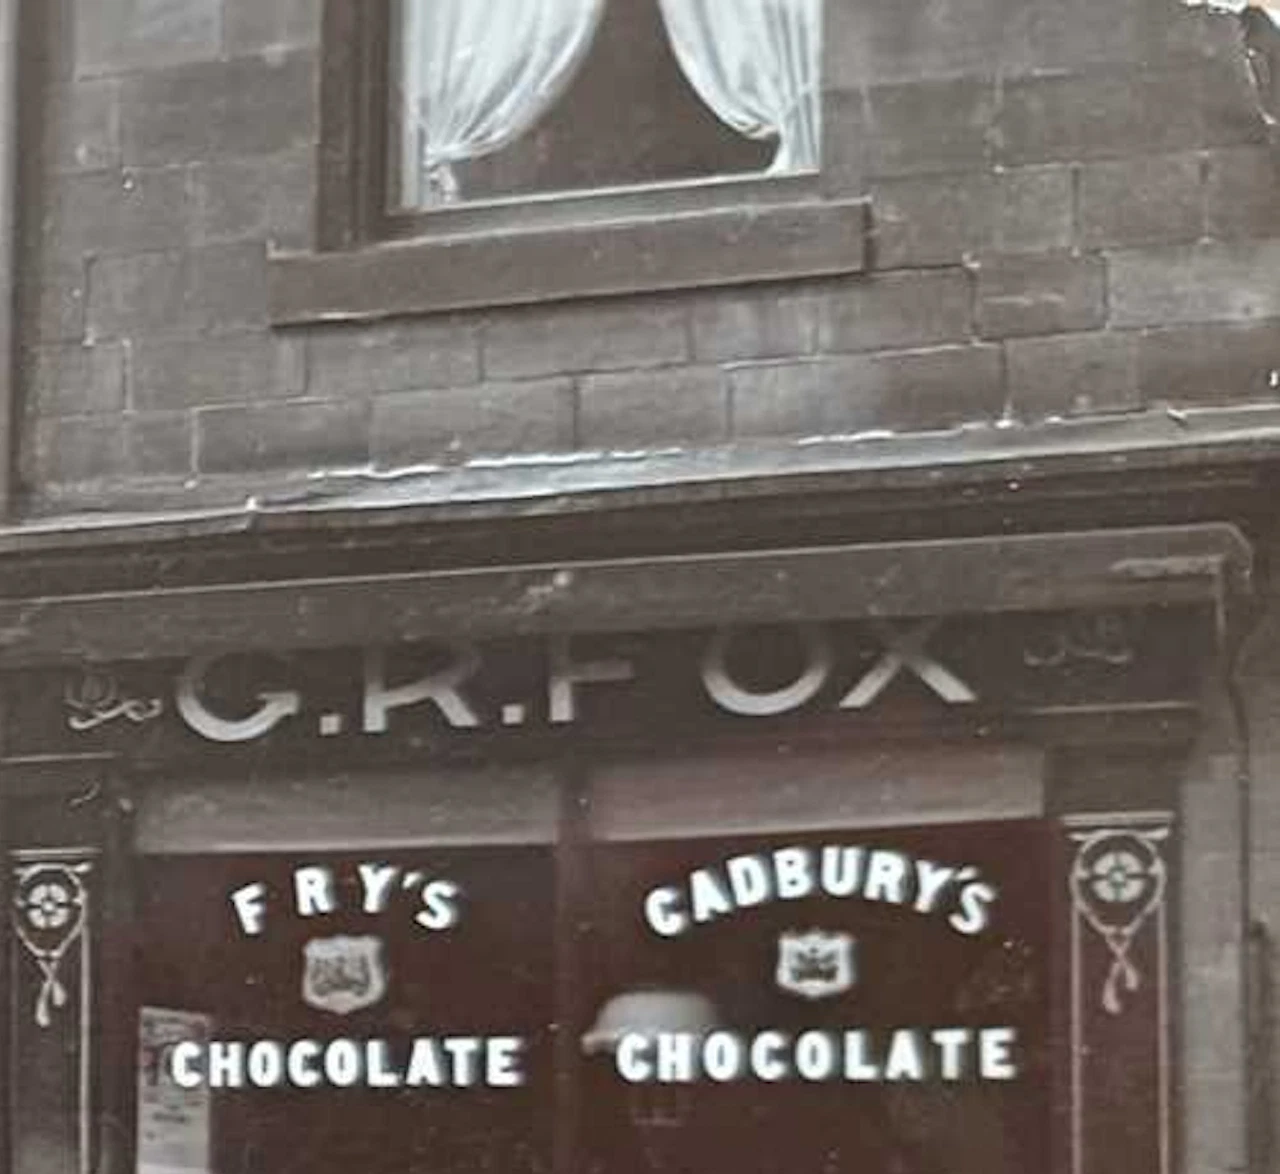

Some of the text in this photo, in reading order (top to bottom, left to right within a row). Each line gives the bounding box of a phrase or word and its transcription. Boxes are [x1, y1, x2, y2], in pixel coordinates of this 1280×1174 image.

[233, 863, 460, 933] FRY'S
[644, 846, 995, 937] CADBURY'S
[171, 1035, 523, 1087] CHOCOLATE
[616, 1027, 1017, 1081] CHOCOLATE
